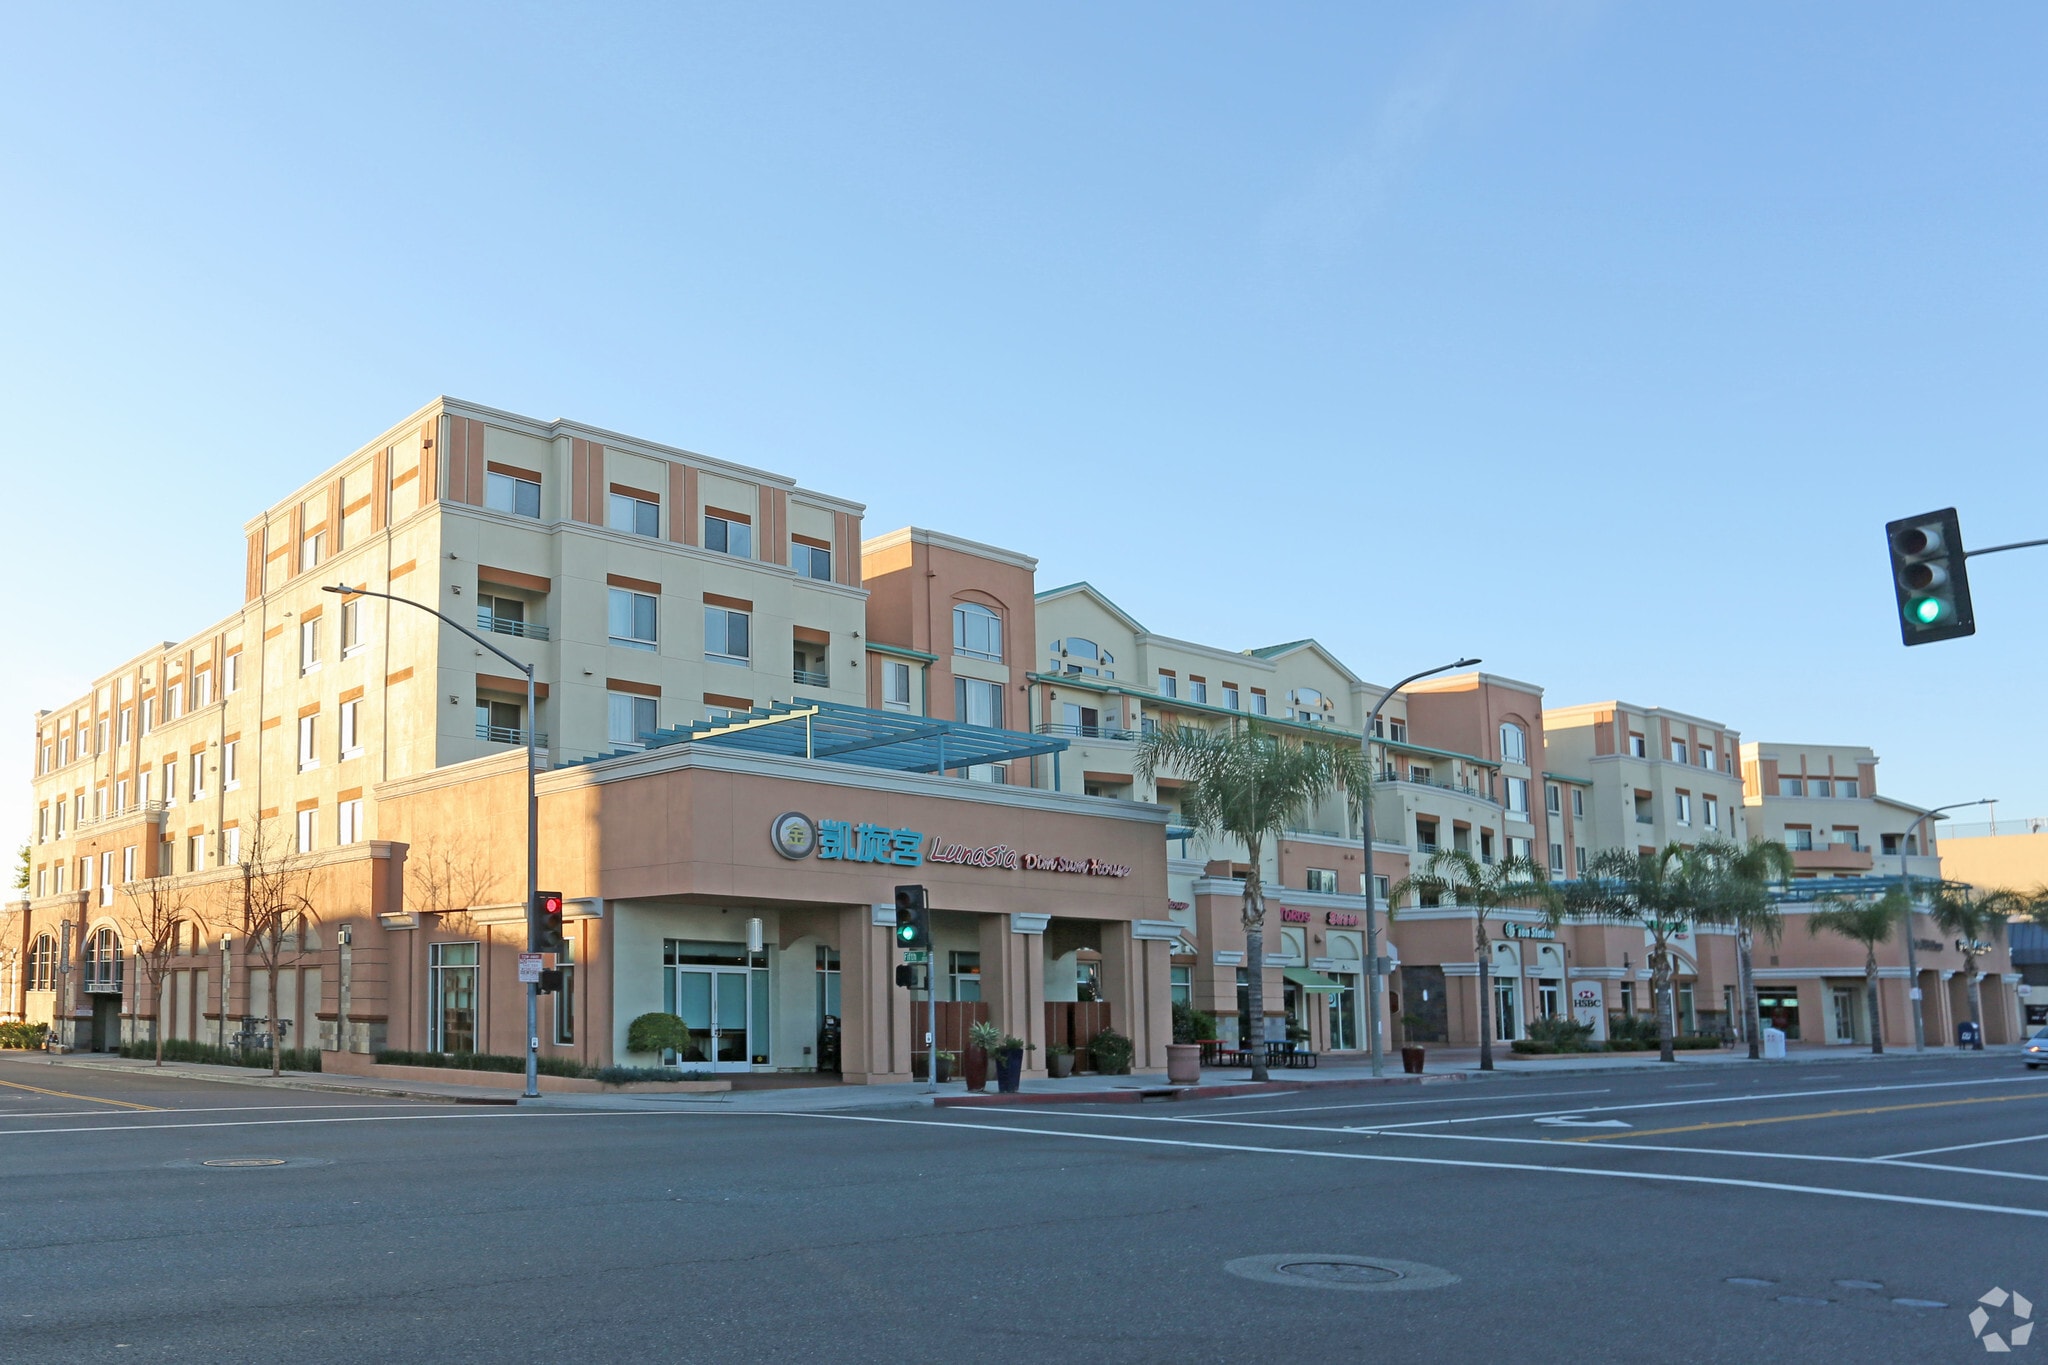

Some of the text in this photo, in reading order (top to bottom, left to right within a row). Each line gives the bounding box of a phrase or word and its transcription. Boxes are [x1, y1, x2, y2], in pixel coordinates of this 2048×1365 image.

[785, 822, 805, 846] 金
[818, 819, 923, 866] 凱旋宮
[928, 836, 1017, 870] Lunasia
[1023, 853, 1131, 878] Dim Sum House
[1574, 999, 1602, 1008] HSBC
